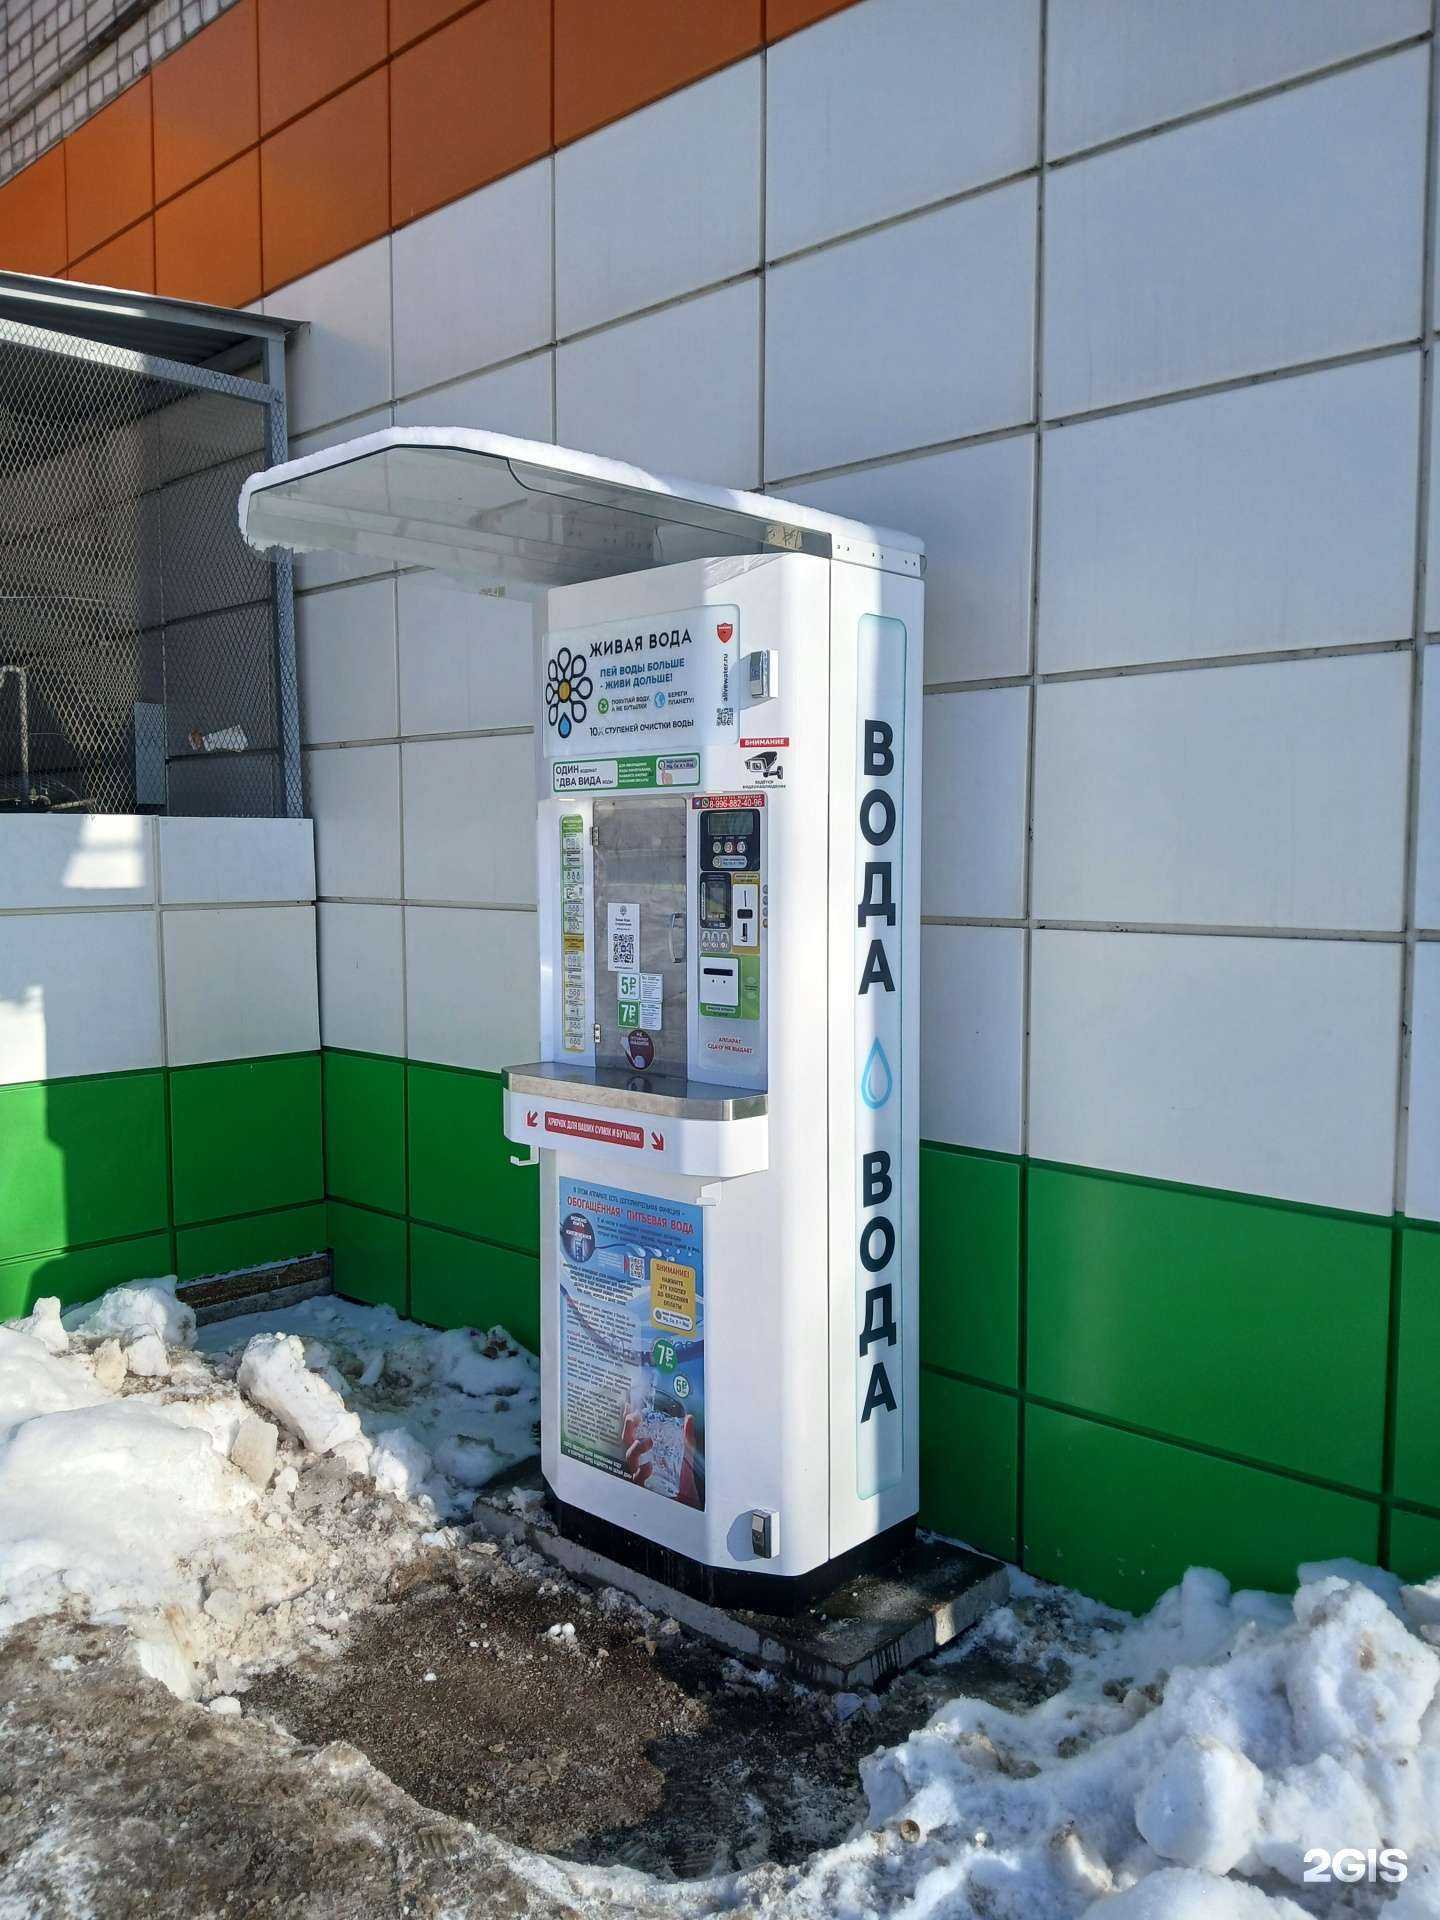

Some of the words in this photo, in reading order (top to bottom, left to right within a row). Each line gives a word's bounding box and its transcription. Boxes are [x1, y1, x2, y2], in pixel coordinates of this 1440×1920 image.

[589, 636, 643, 657] ЖИВАЯ
[649, 628, 692, 648] ВОДА
[600, 667, 618, 678] ПЕЙ
[620, 663, 645, 676] ВОДЫ
[647, 658, 685, 671] БОЛЬШЕ
[721, 653, 729, 702] alivewater.ru
[605, 678, 631, 690] ЖИВИ
[633, 673, 673, 685] ДОЛЬШЕ!
[605, 723, 639, 735] СТУПЕНЕЙ
[640, 721, 671, 732] ОЧИСТКИ
[672, 719, 694, 728] ВОДЫ
[555, 765, 579, 776] ОДИН
[578, 776, 601, 787] ВИДА
[857, 718, 897, 995] ВОДА
[626, 1209, 668, 1228] ПИТЬЕВАЯ
[671, 1221, 694, 1235] ВОДА
[859, 1150, 898, 1424] ВОДА
